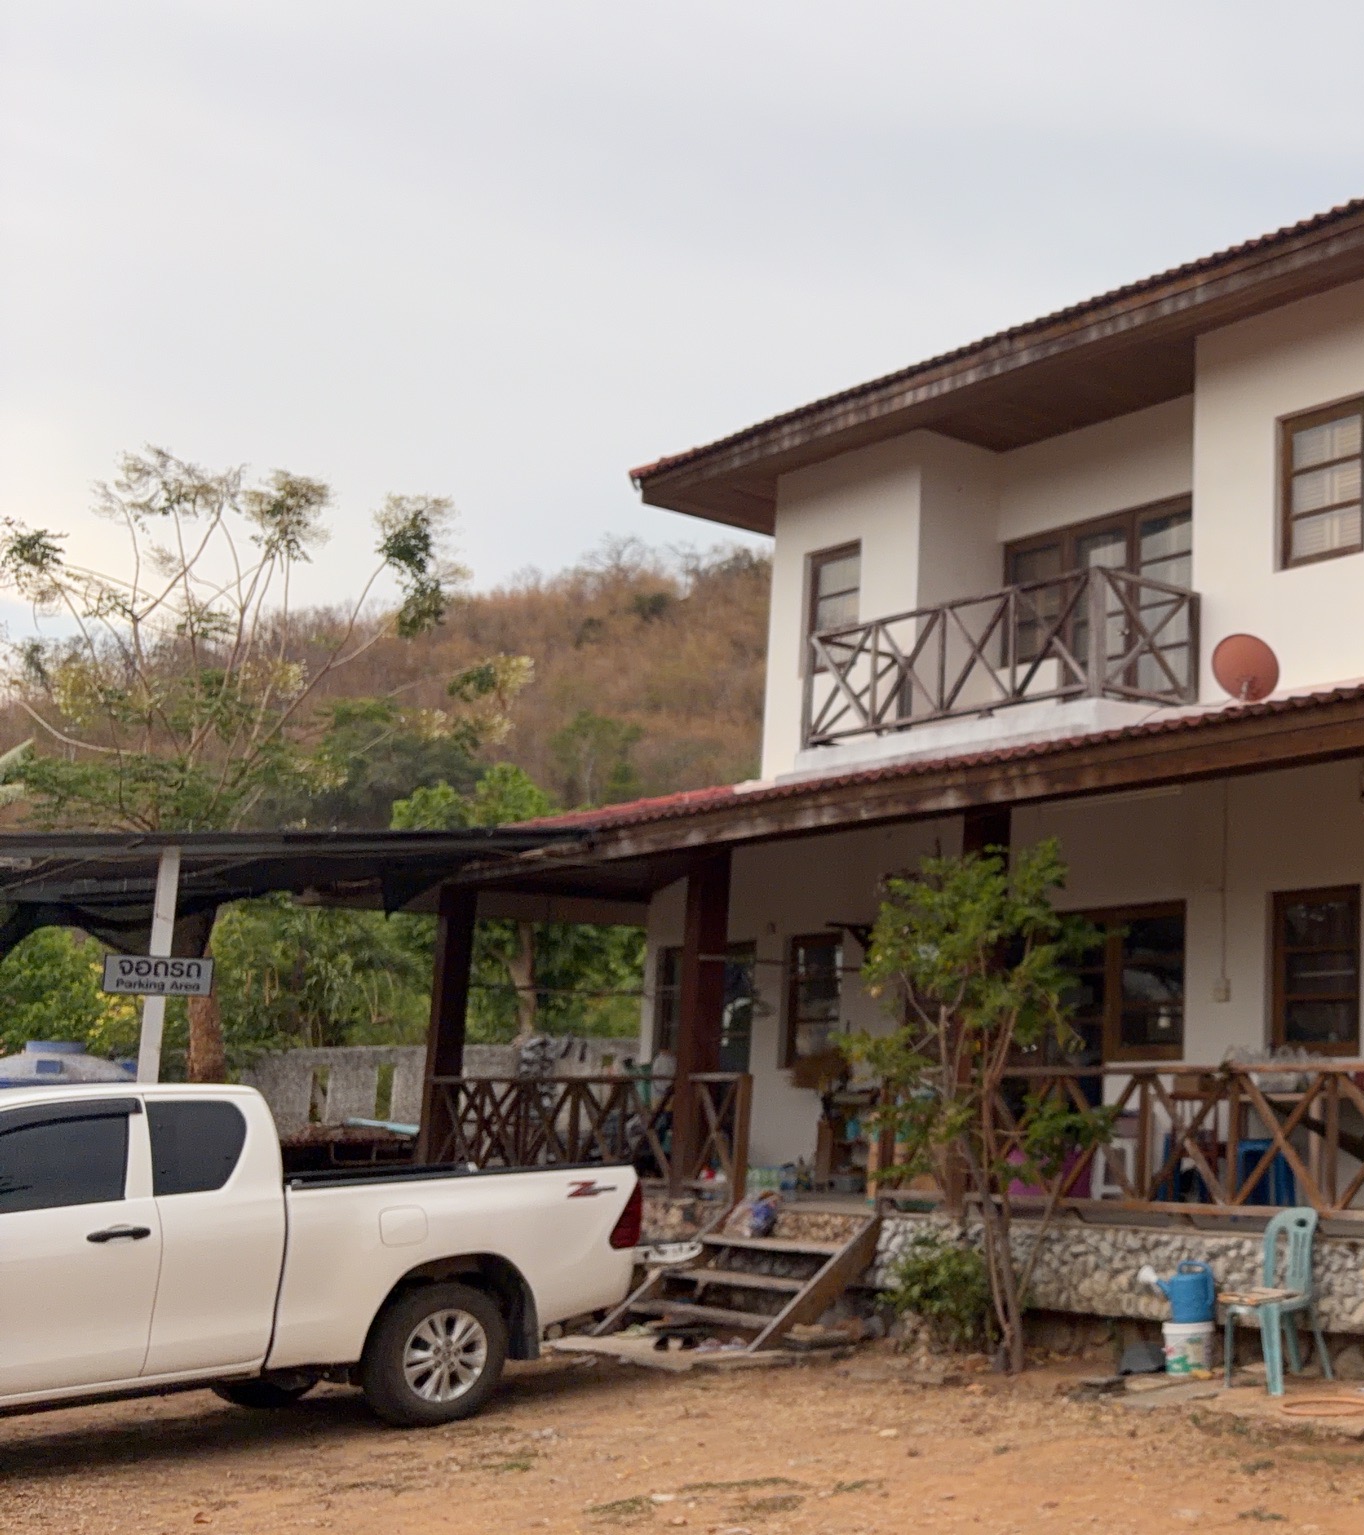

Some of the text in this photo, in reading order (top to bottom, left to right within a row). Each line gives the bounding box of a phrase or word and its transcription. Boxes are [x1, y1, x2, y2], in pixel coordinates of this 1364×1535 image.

[119, 959, 202, 979] จอดรถ
[115, 978, 200, 992] Parking Area
